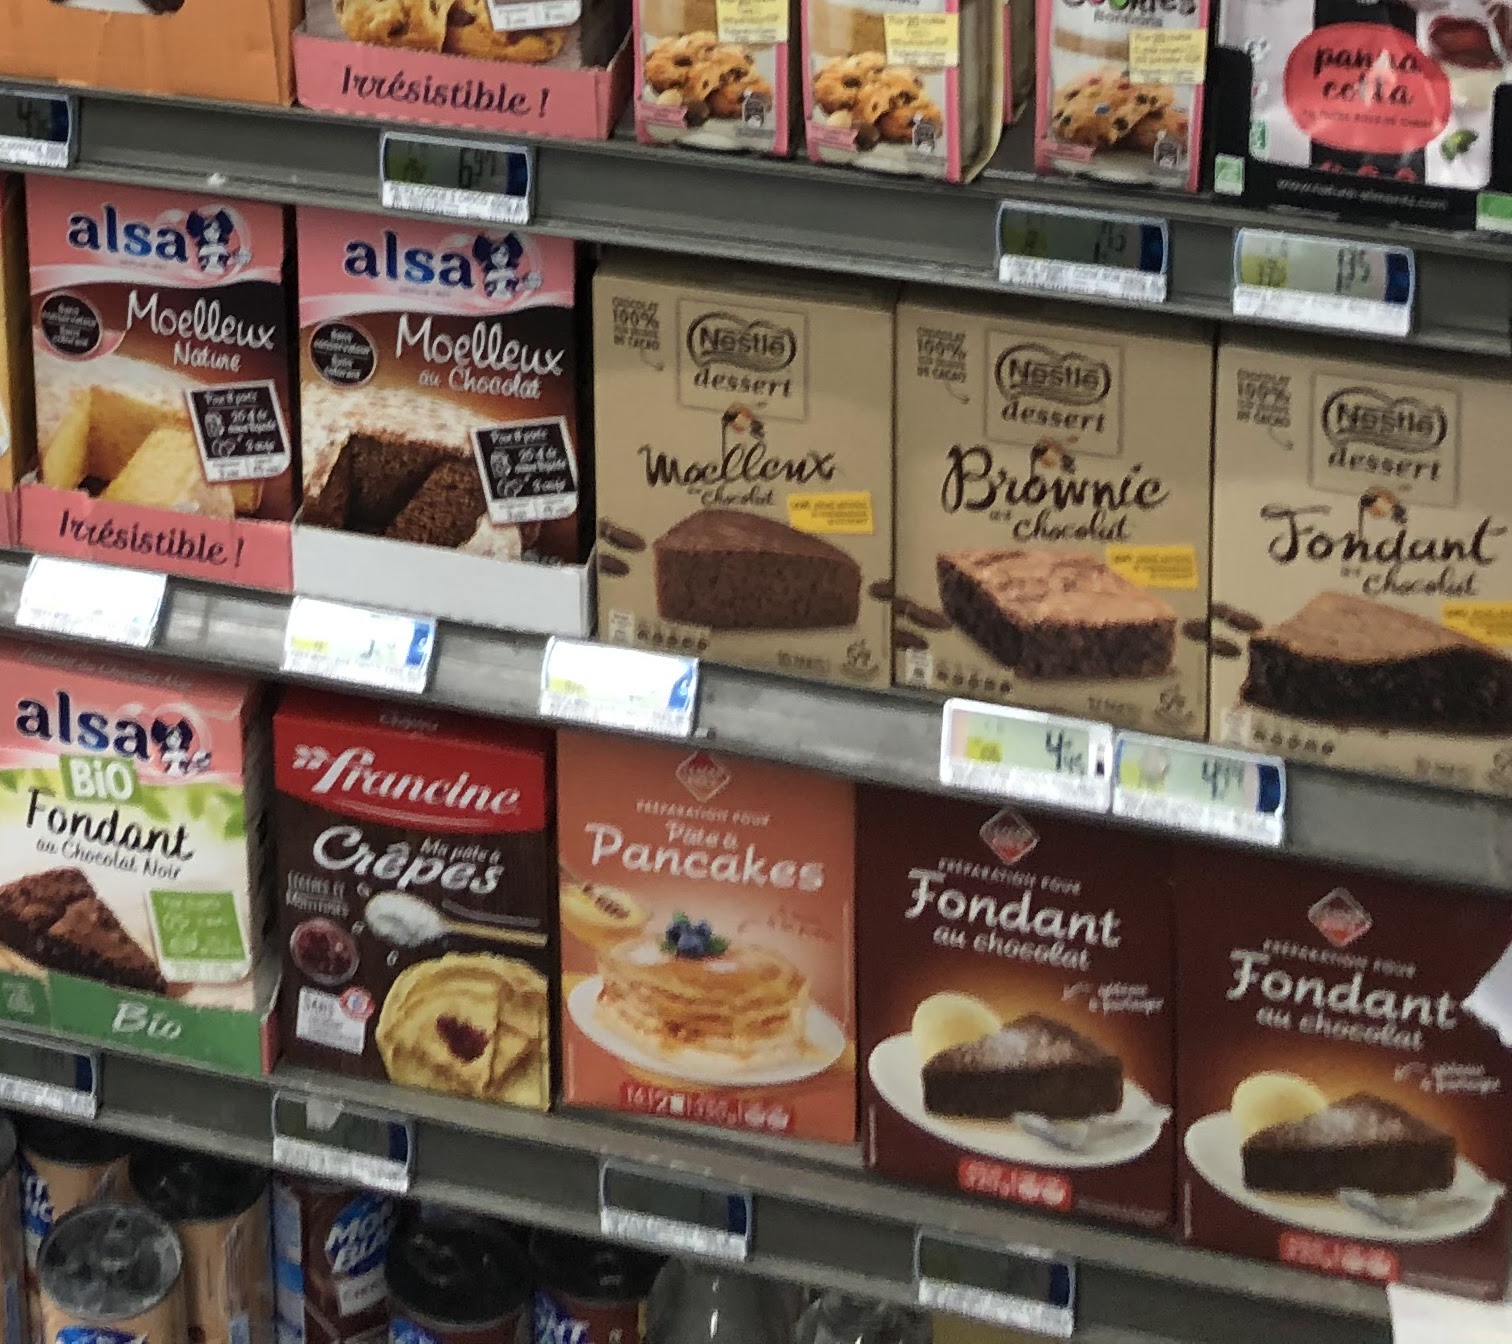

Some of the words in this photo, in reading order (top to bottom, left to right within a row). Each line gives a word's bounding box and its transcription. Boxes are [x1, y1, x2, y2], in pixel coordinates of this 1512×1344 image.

[66, 204, 188, 266] alsa
[343, 226, 474, 293] alsa
[124, 290, 277, 355] Moelleux
[394, 314, 565, 379] Moelleux
[698, 322, 790, 362] Nestlé
[173, 342, 241, 374] Nature
[418, 369, 443, 388] au
[448, 366, 544, 401] Chocolat
[692, 366, 798, 400] dessert
[1000, 399, 1110, 435] dessert
[639, 443, 839, 489] Moelleux
[940, 443, 1173, 515] Brownie
[1327, 446, 1444, 484] dessert
[1259, 505, 1508, 572] Fondant
[15, 689, 151, 762] alsa
[317, 742, 523, 822] francine
[26, 786, 197, 864] Fondant
[583, 820, 829, 893] Pancakes
[36, 840, 59, 855] au
[60, 839, 140, 875] Chocolat
[142, 856, 183, 882] Noir
[311, 823, 508, 895] Crêpes
[903, 867, 1123, 951] Fondant
[933, 924, 967, 950] au
[972, 924, 1092, 973] chocolat
[1224, 947, 1461, 1032] Fondant
[110, 1001, 183, 1043] Bio
[1254, 1009, 1292, 1031] au
[1297, 1014, 1426, 1055] chocolat
